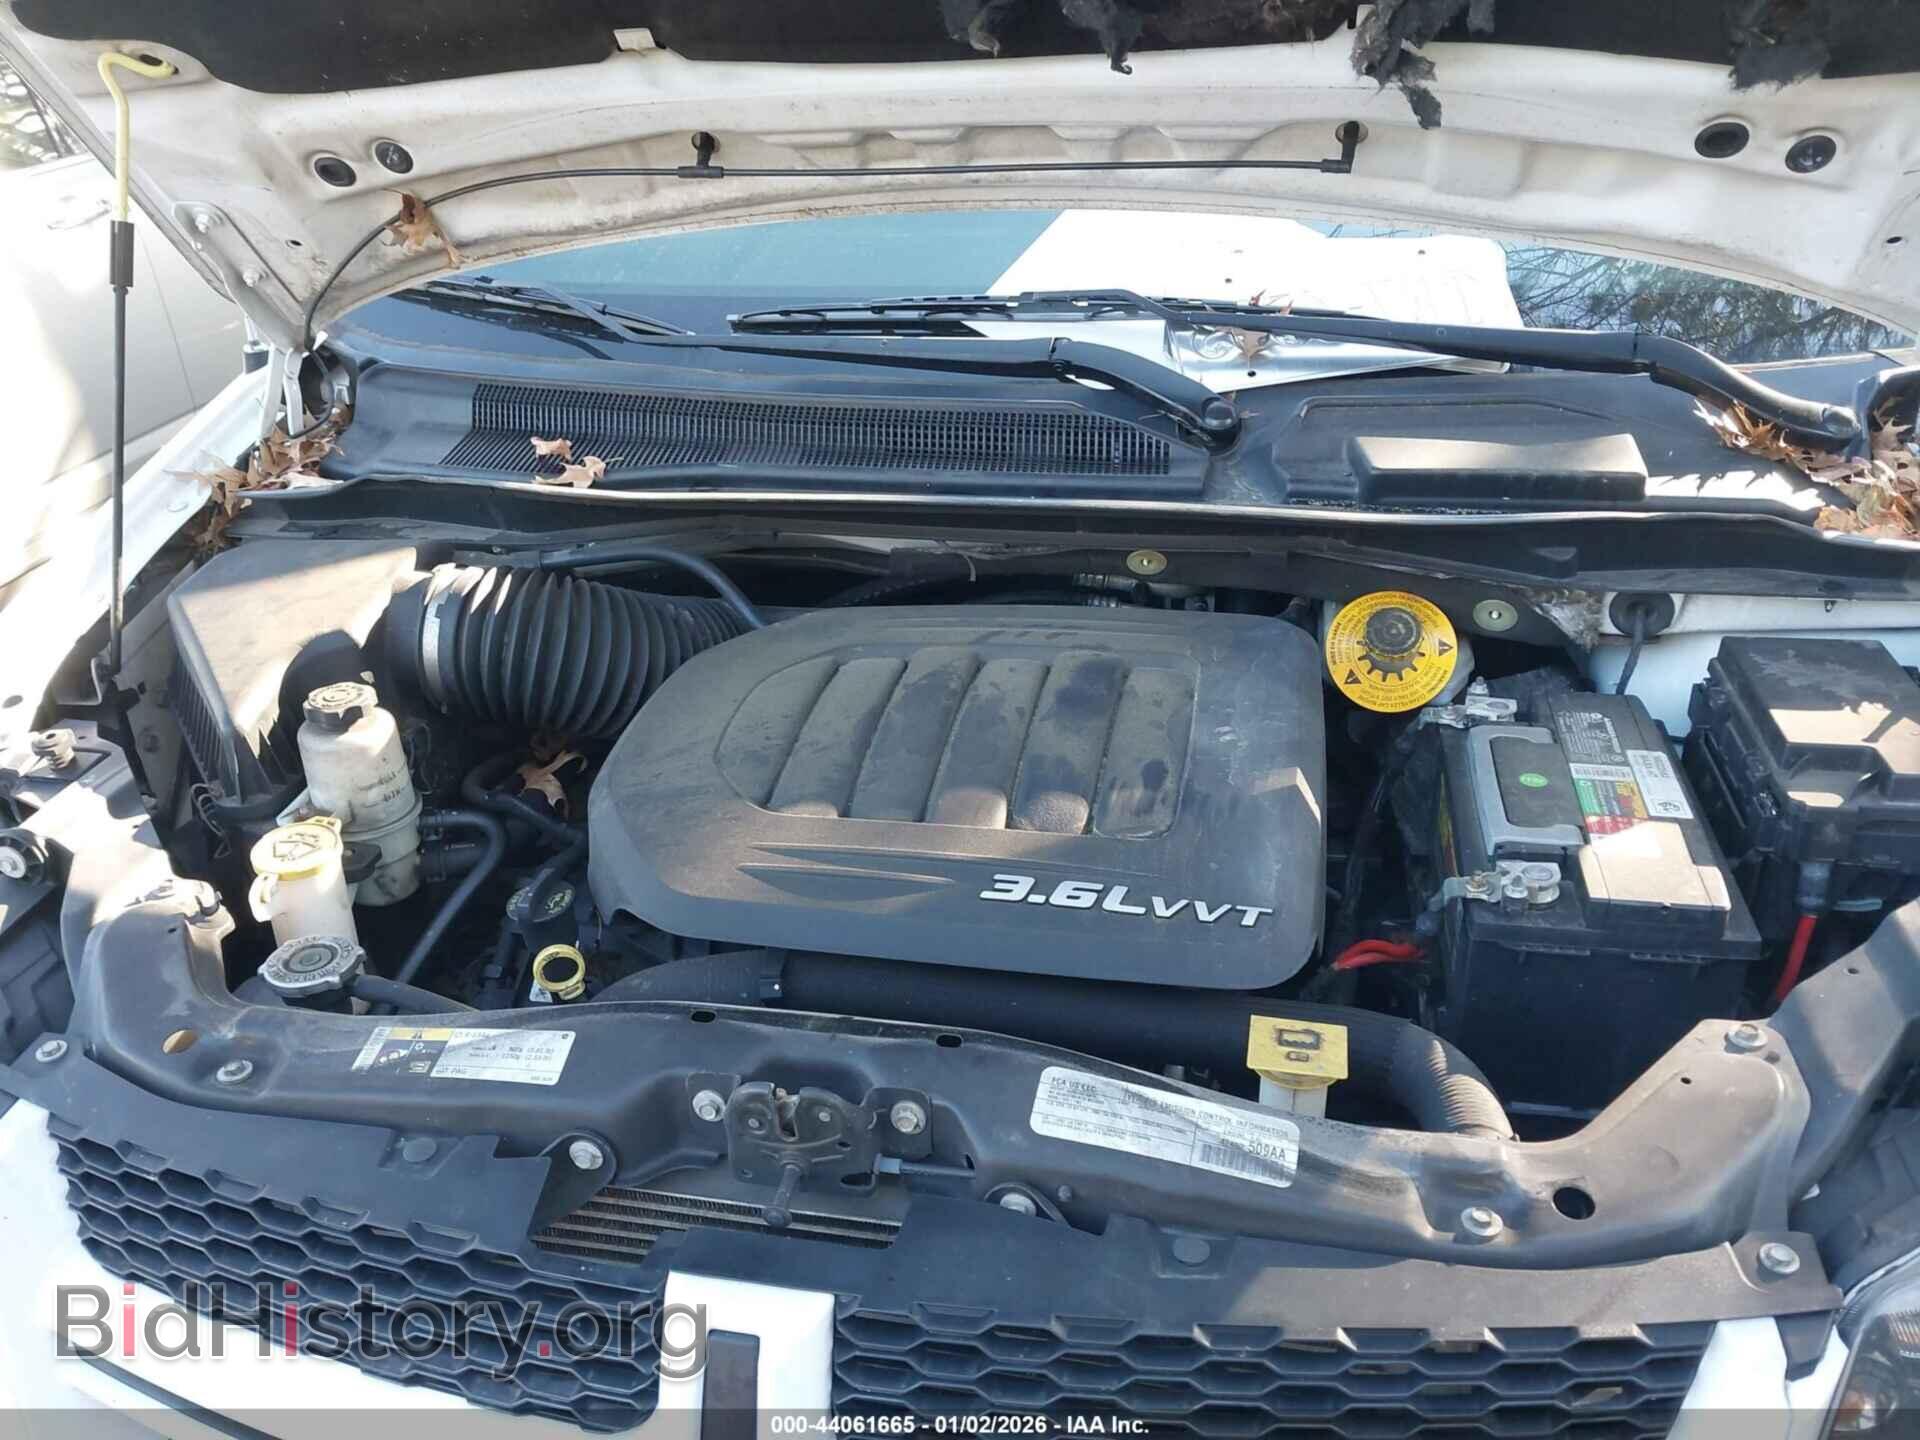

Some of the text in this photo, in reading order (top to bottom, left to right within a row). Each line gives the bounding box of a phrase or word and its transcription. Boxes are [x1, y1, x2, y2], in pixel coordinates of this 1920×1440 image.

[979, 873, 1273, 927] 3.6L VVT
[1248, 1140, 1287, 1161] 509AA
